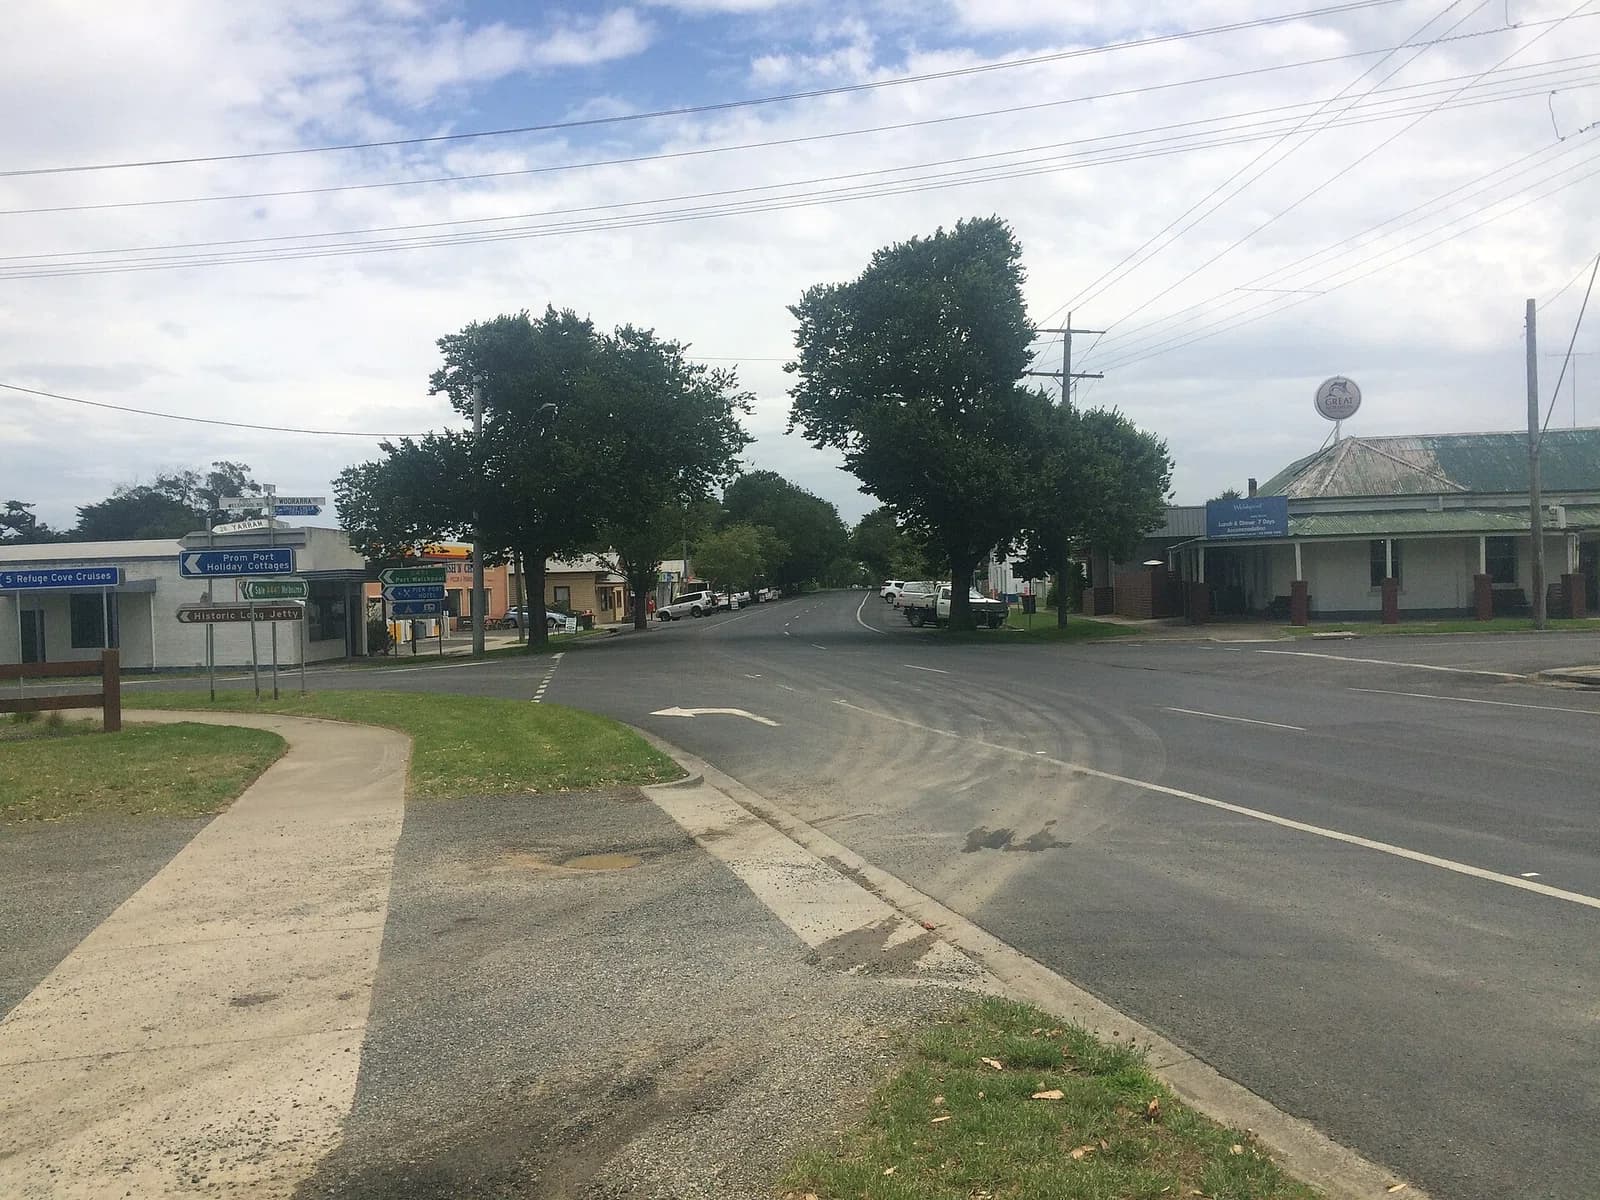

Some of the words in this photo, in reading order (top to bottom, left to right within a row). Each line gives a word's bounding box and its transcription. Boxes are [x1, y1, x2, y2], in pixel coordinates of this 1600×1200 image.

[232, 520, 263, 531] YARRAM
[223, 554, 248, 562] Prom
[253, 553, 274, 561] Port
[207, 563, 243, 572] Holiday
[248, 561, 290, 571] Cottages
[16, 574, 48, 585] Refuge
[51, 573, 73, 582] Cove
[76, 571, 112, 581] Cruises
[194, 610, 236, 620] Historic
[270, 608, 299, 619] Jetty
